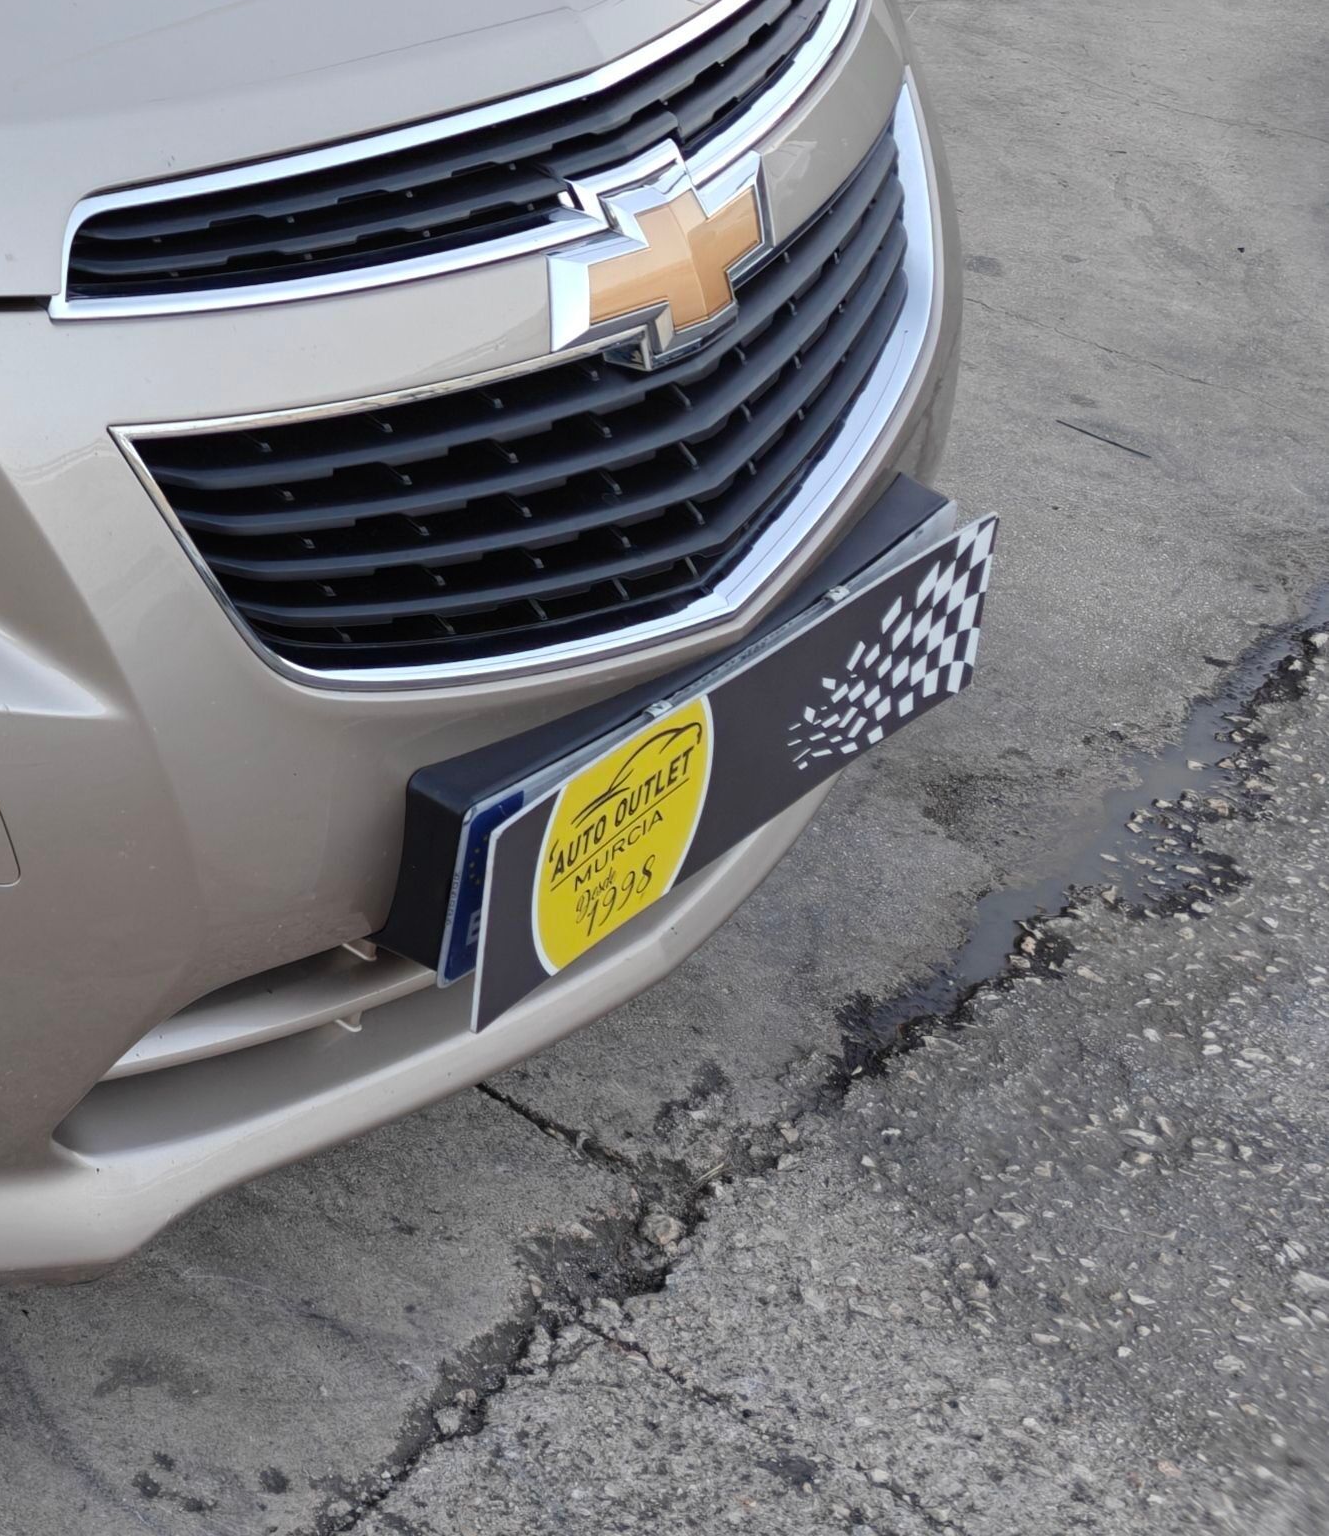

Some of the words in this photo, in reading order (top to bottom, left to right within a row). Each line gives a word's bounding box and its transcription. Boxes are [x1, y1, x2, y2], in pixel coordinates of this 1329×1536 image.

[614, 745, 695, 827] OUTLET
[574, 810, 663, 892] MURCIA
[587, 854, 656, 937] 1998
